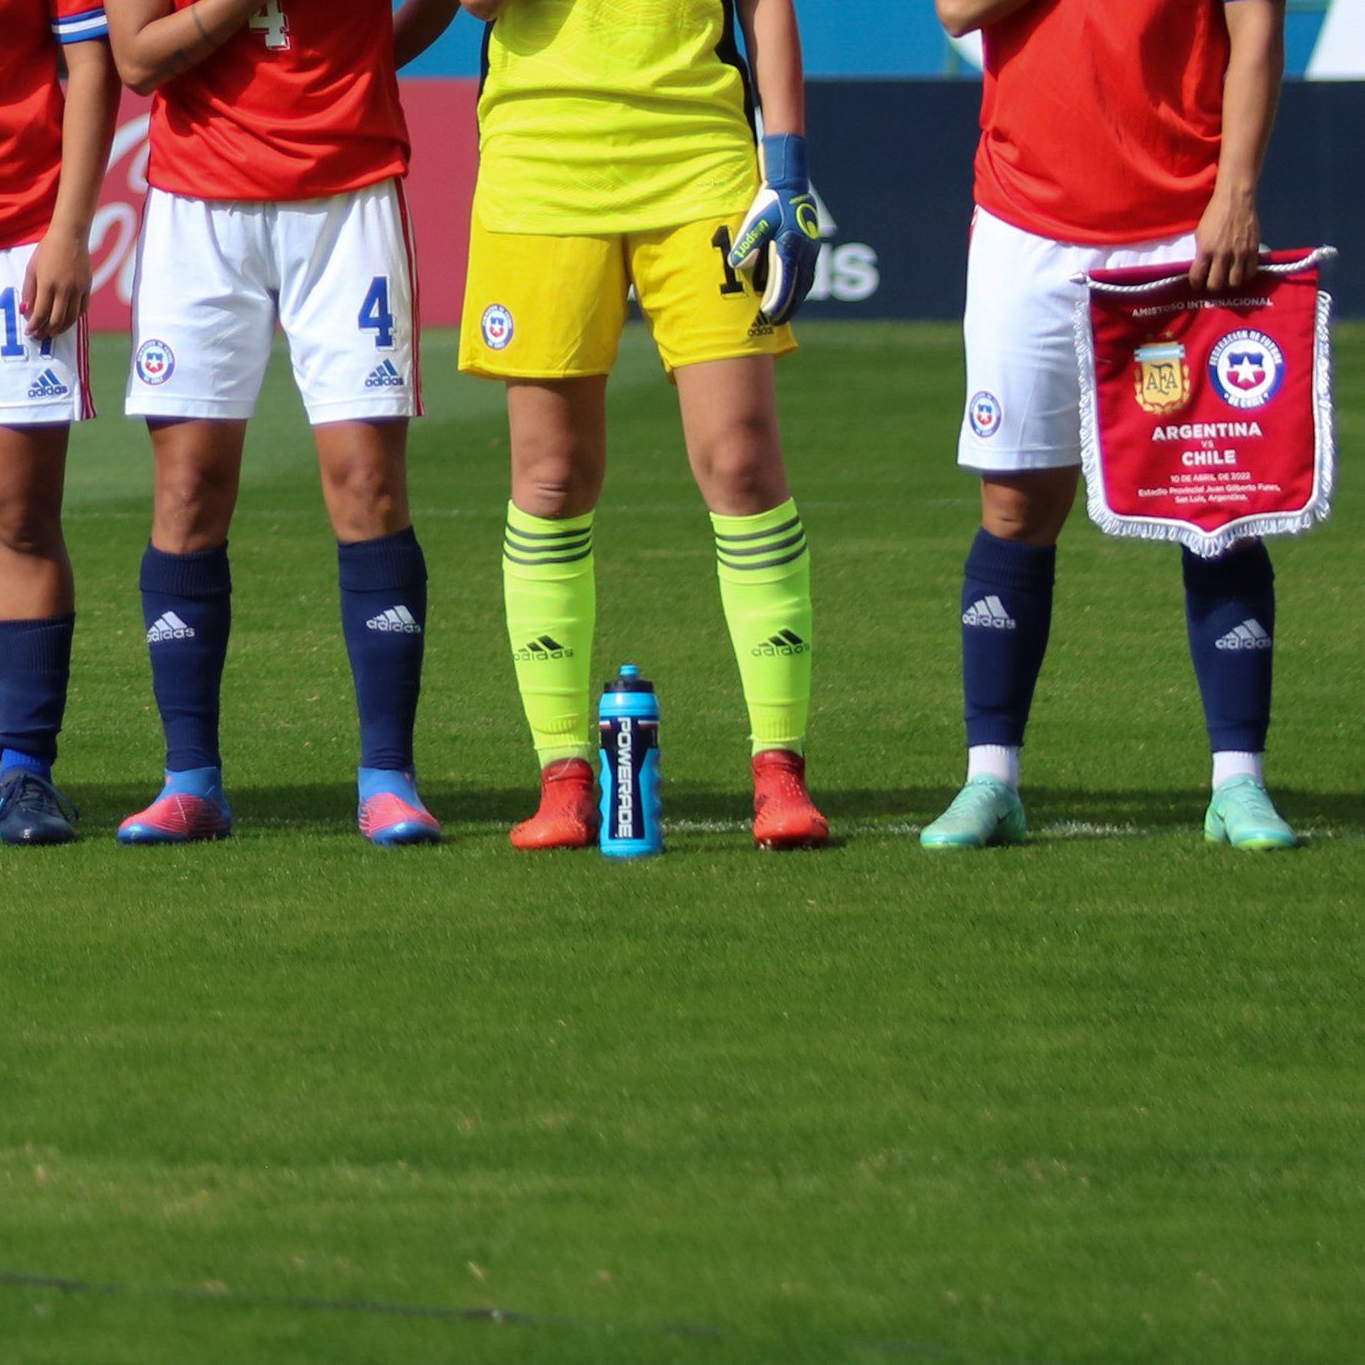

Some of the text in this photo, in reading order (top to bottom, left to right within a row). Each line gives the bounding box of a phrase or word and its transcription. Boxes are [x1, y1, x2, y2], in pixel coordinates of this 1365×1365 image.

[357, 275, 397, 353] 4
[1132, 297, 1274, 318] AMISTOSO INTERNACIONAL
[365, 372, 404, 388] adidas
[1146, 363, 1178, 395] AFA
[27, 382, 68, 398] adidas
[1152, 422, 1262, 441] ARGENTINA
[1181, 450, 1236, 466] CHILE
[1170, 475, 1179, 483] 10
[1181, 474, 1192, 482] DE
[1193, 474, 1216, 483] ABRIL
[1218, 473, 1229, 481] DE
[1138, 488, 1168, 497] Estadio
[1169, 485, 1205, 495] Provincial
[1206, 485, 1225, 494] Juan
[1175, 495, 1188, 504] San
[366, 617, 421, 634] adidas
[962, 612, 1016, 630] adidas
[147, 626, 196, 644] adidas
[513, 646, 574, 662] adidas
[751, 641, 811, 658] adidas
[617, 716, 634, 839] POWERADE
